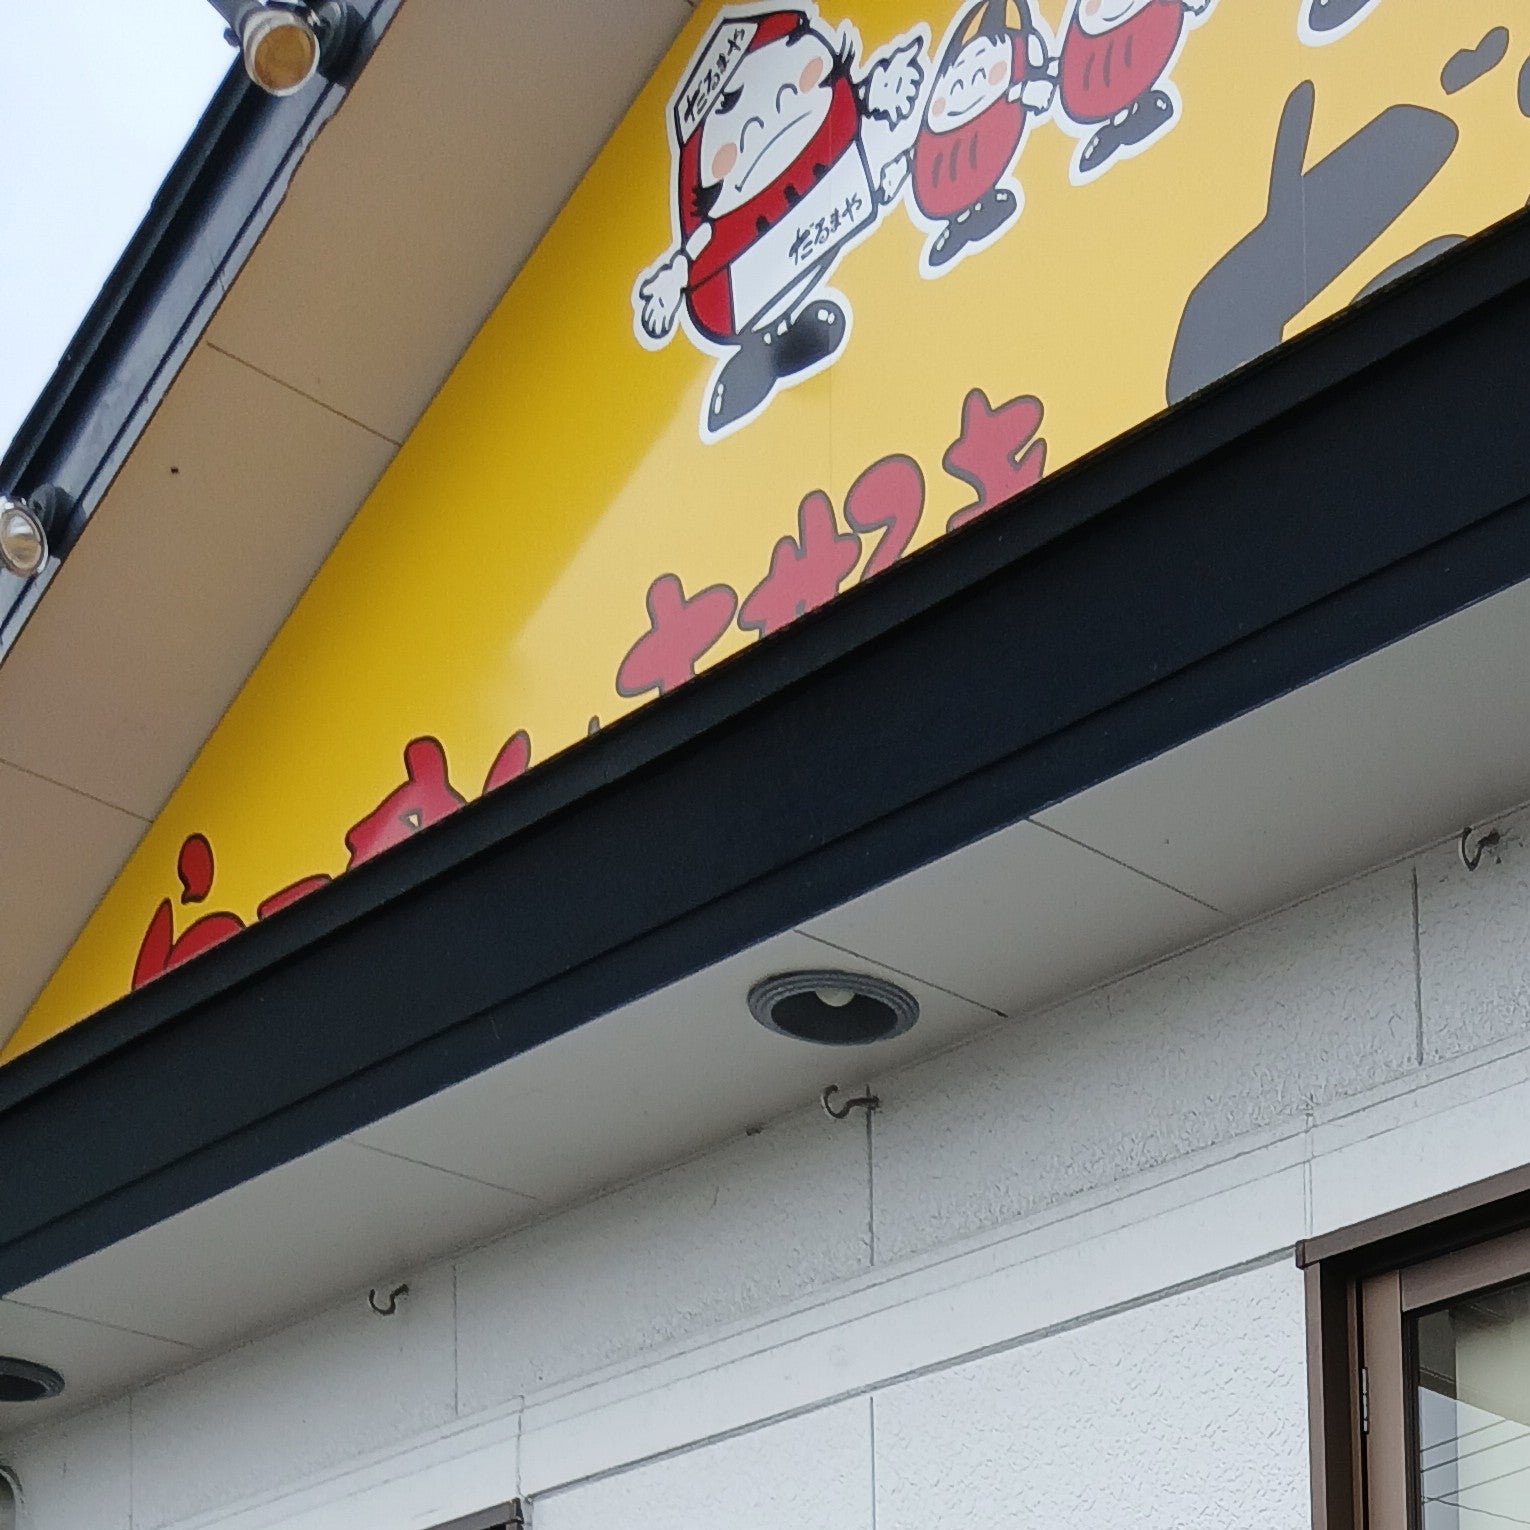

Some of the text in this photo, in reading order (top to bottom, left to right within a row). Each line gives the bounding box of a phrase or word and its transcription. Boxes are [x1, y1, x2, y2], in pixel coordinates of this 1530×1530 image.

[684, 28, 746, 123] だるまや
[789, 192, 863, 266] だるまや
